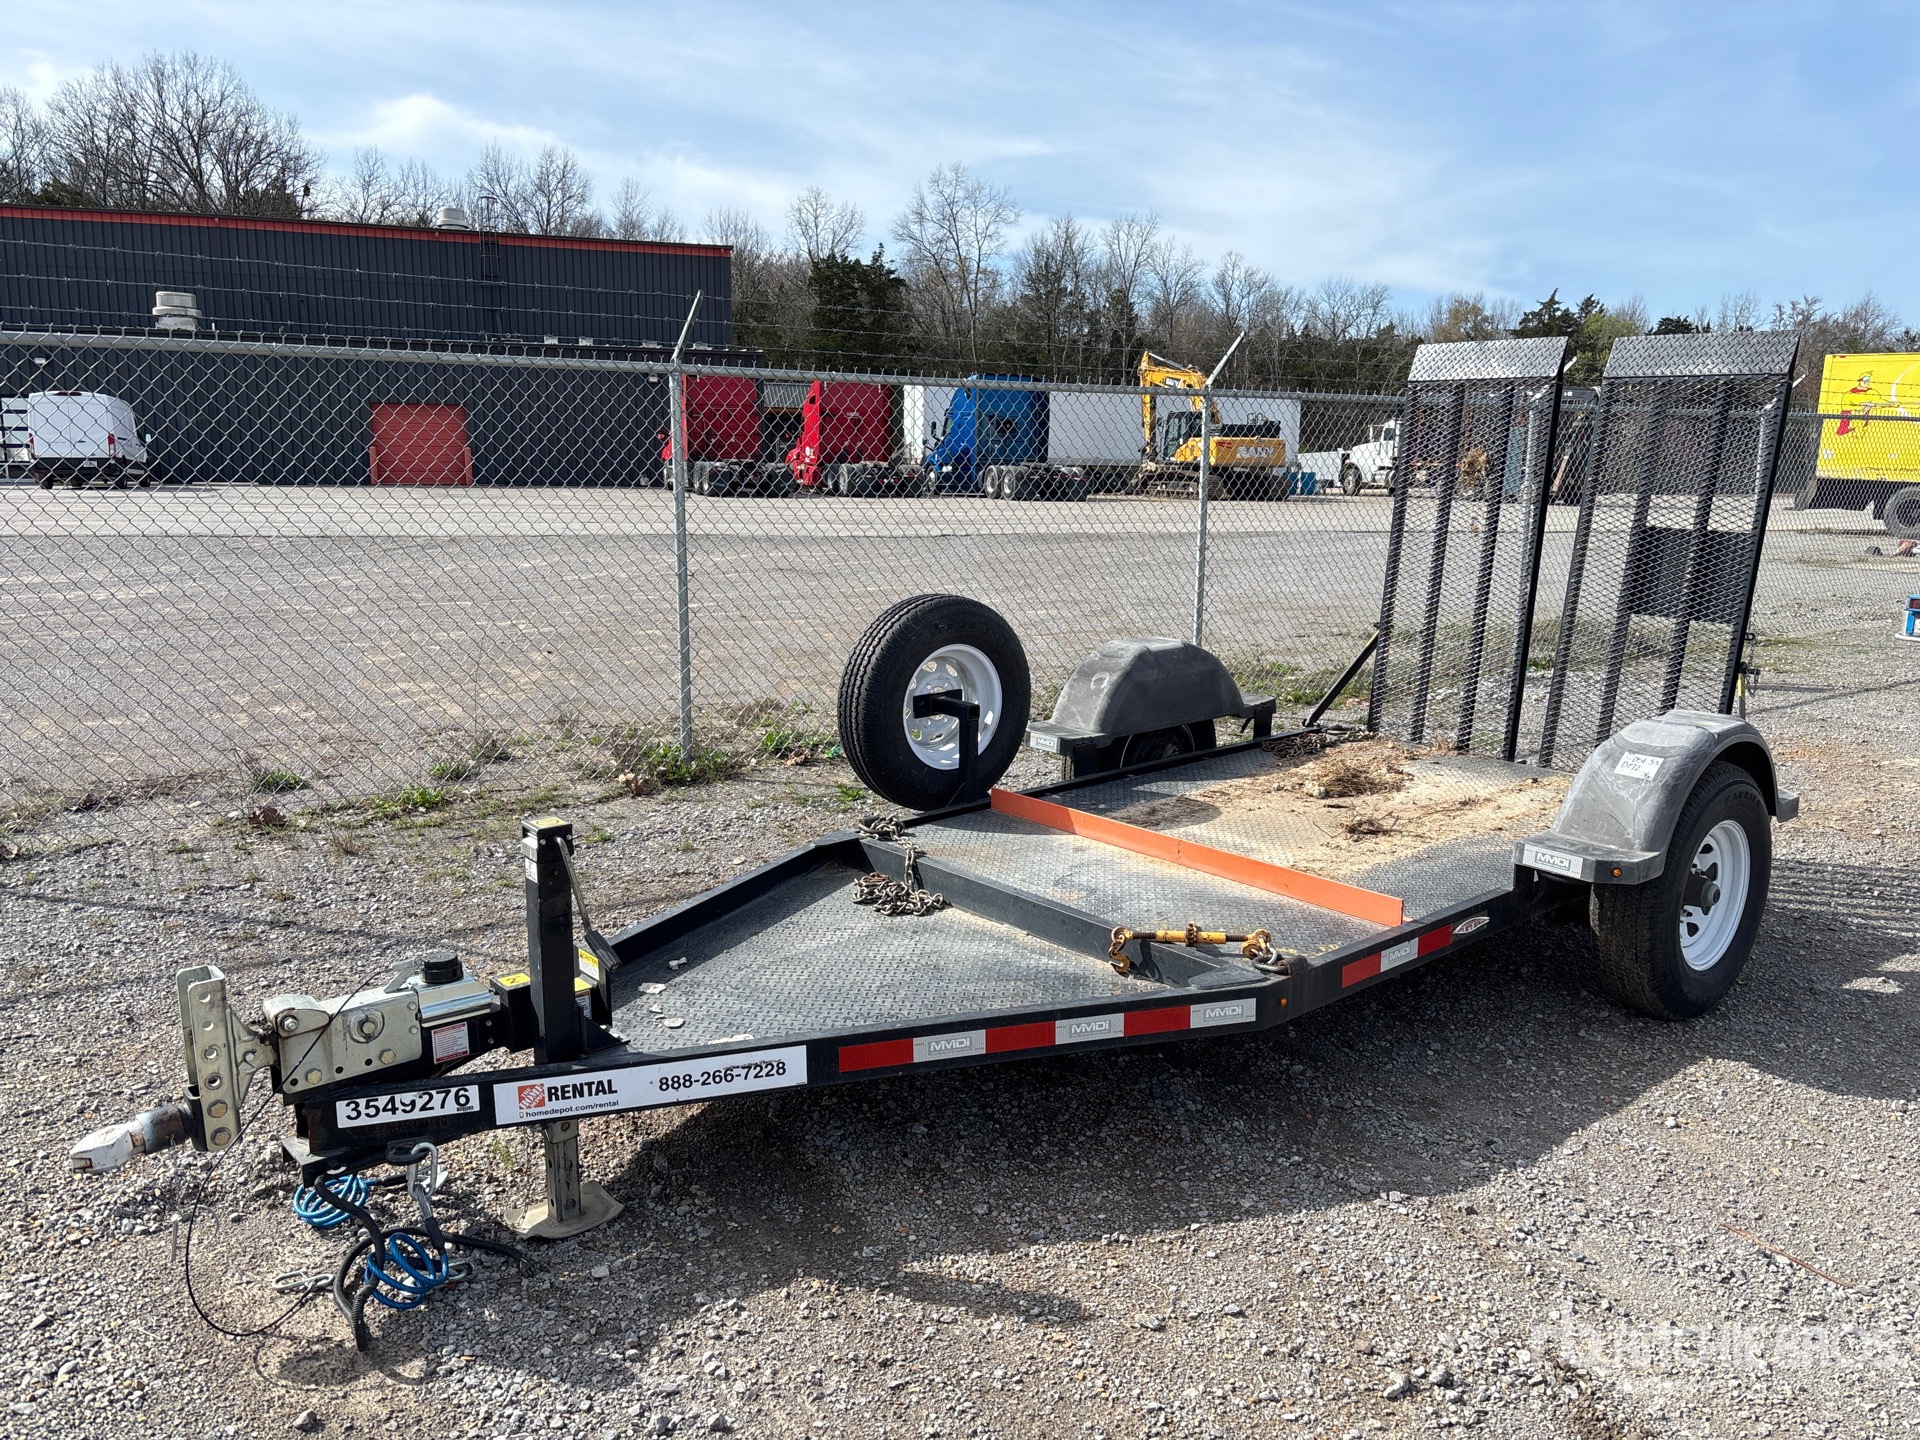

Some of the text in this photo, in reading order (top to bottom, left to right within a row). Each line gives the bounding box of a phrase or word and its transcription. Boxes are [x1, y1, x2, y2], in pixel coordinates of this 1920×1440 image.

[658, 1061, 787, 1092] 888-266-7228
[519, 1083, 545, 1109] HOME
[520, 1086, 532, 1098] THE
[547, 1079, 618, 1102] RENTAL
[344, 1087, 471, 1121] 3549276
[525, 1100, 619, 1118] homedepot.com/rental
